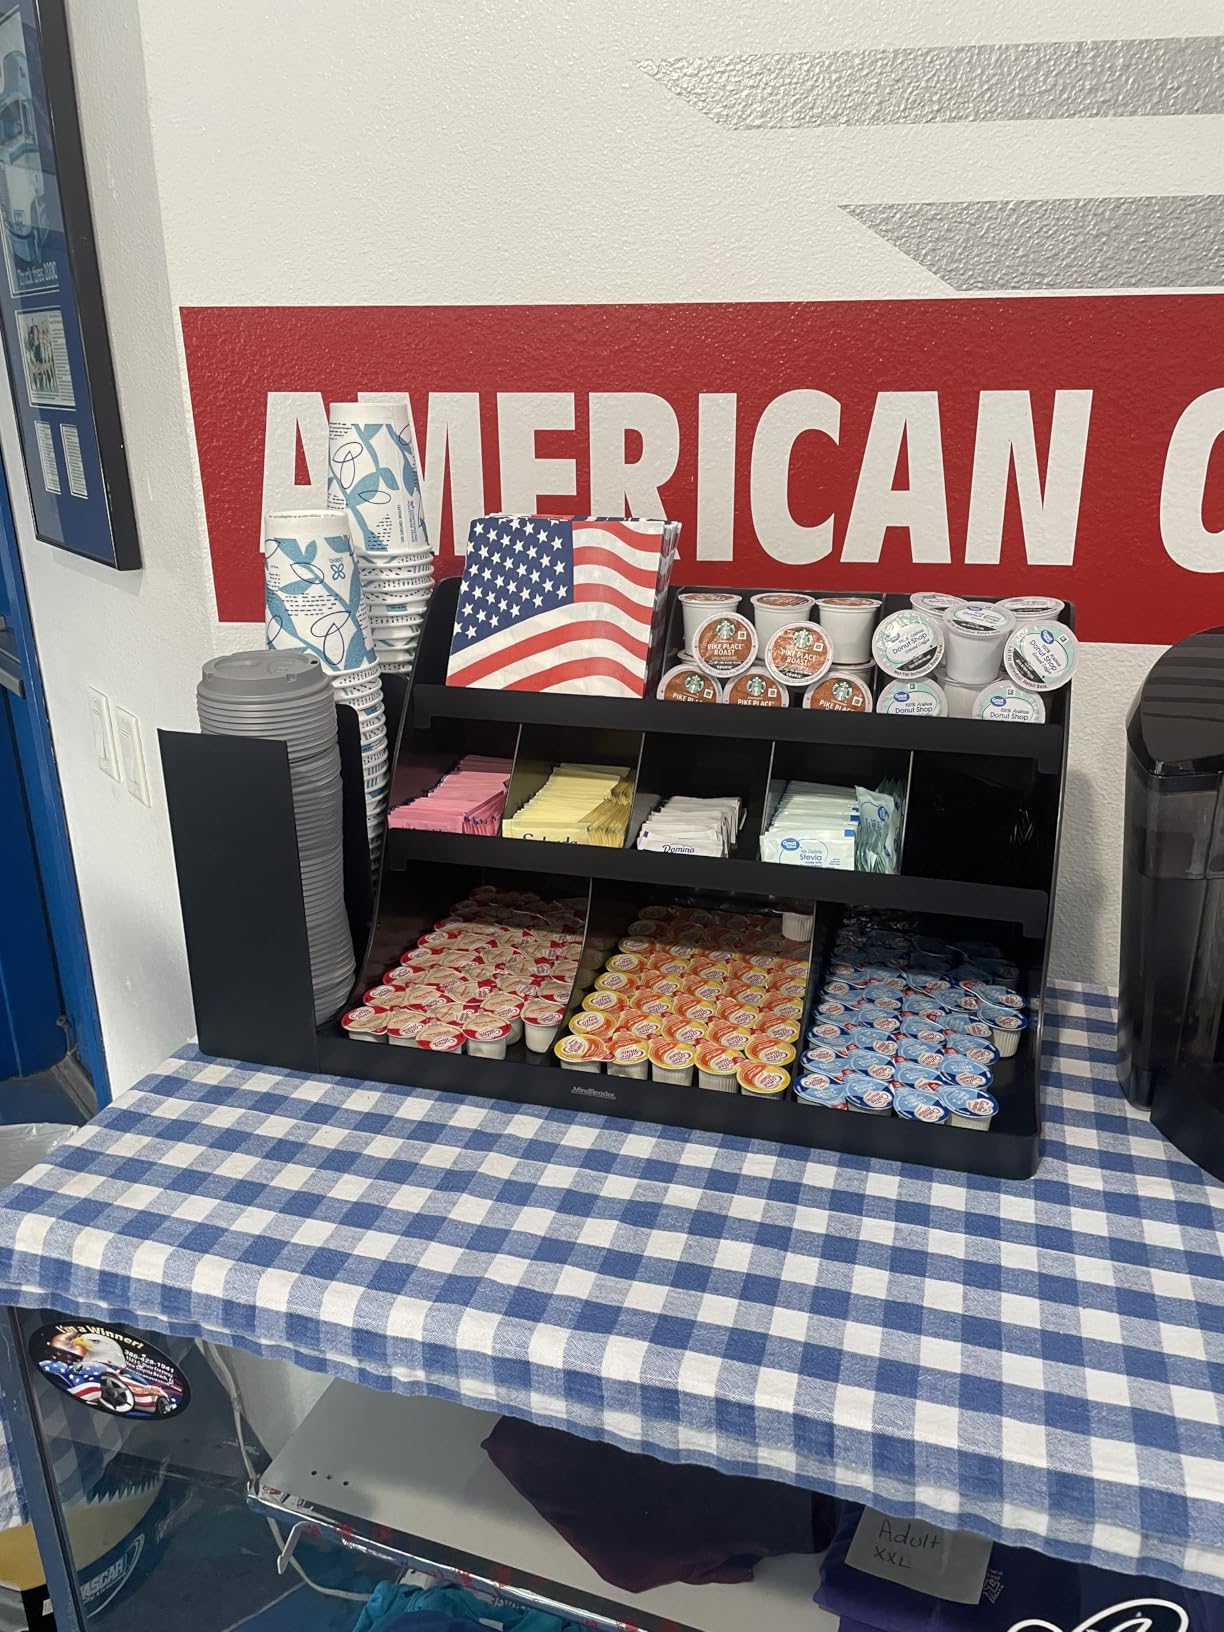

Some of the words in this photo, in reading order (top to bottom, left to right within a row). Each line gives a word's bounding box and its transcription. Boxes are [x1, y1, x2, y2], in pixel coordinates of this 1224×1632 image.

[259, 389, 1094, 566] AMERICAN
[892, 641, 912, 655] Donut
[910, 632, 928, 644] Shop
[1029, 639, 1046, 657] Donut
[1044, 655, 1057, 671] Shop
[672, 692, 687, 701] PIKE
[819, 700, 834, 709] PIKE
[895, 706, 915, 714] Donut
[916, 706, 933, 715] Shop
[990, 711, 1010, 719] Donut
[1010, 713, 1029, 721] Shop
[662, 844, 695, 854] Domino
[799, 853, 823, 861] Stevia
[86, 1326, 144, 1349] Winner!
[879, 1519, 941, 1549] Adult
[873, 1545, 913, 1569] XXL
[80, 1556, 126, 1601] ASCAR
